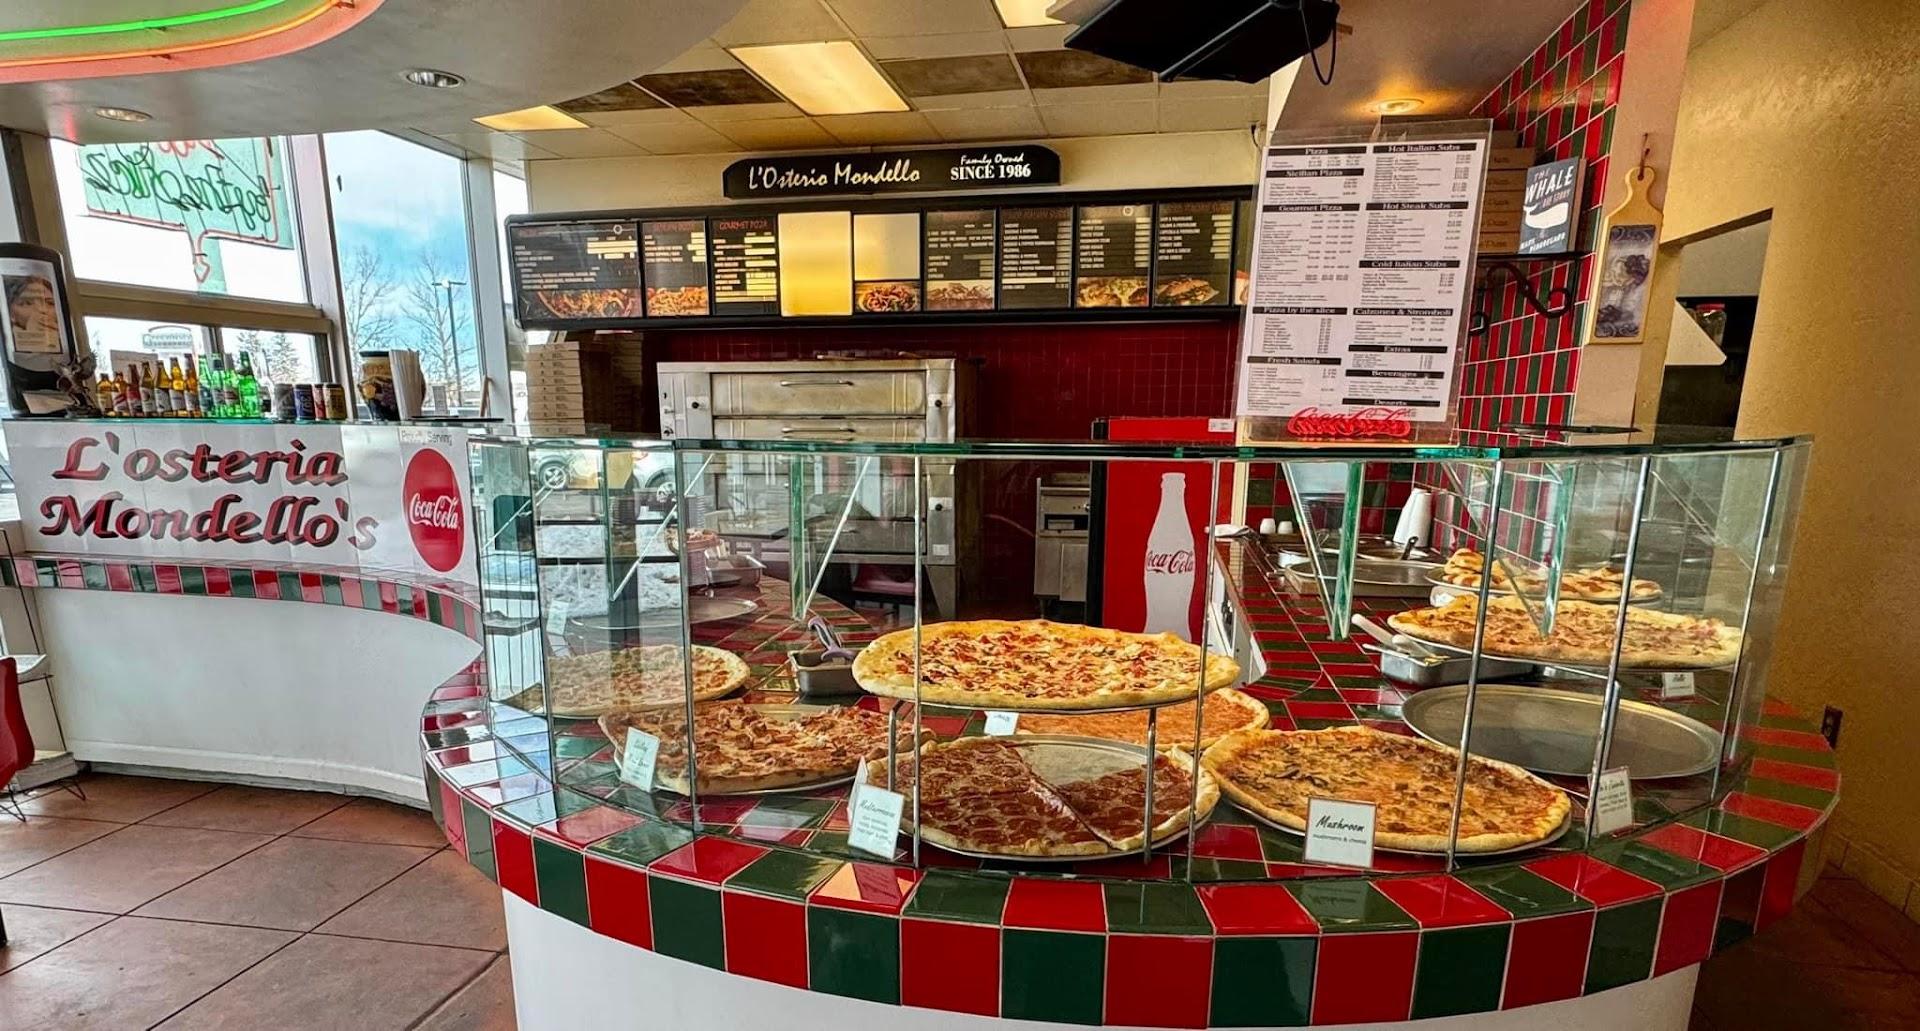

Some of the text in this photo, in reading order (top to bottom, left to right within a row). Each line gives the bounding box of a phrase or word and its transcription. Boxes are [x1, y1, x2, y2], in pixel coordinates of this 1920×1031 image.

[833, 158, 921, 186] Mondello
[950, 162, 1031, 181] SINCE 1986
[960, 154, 993, 168] Family
[1525, 165, 1574, 205] WHALE
[39, 490, 380, 550] Mondello's
[409, 492, 460, 530] Coca-Cola
[1315, 815, 1365, 832] Mushroom
